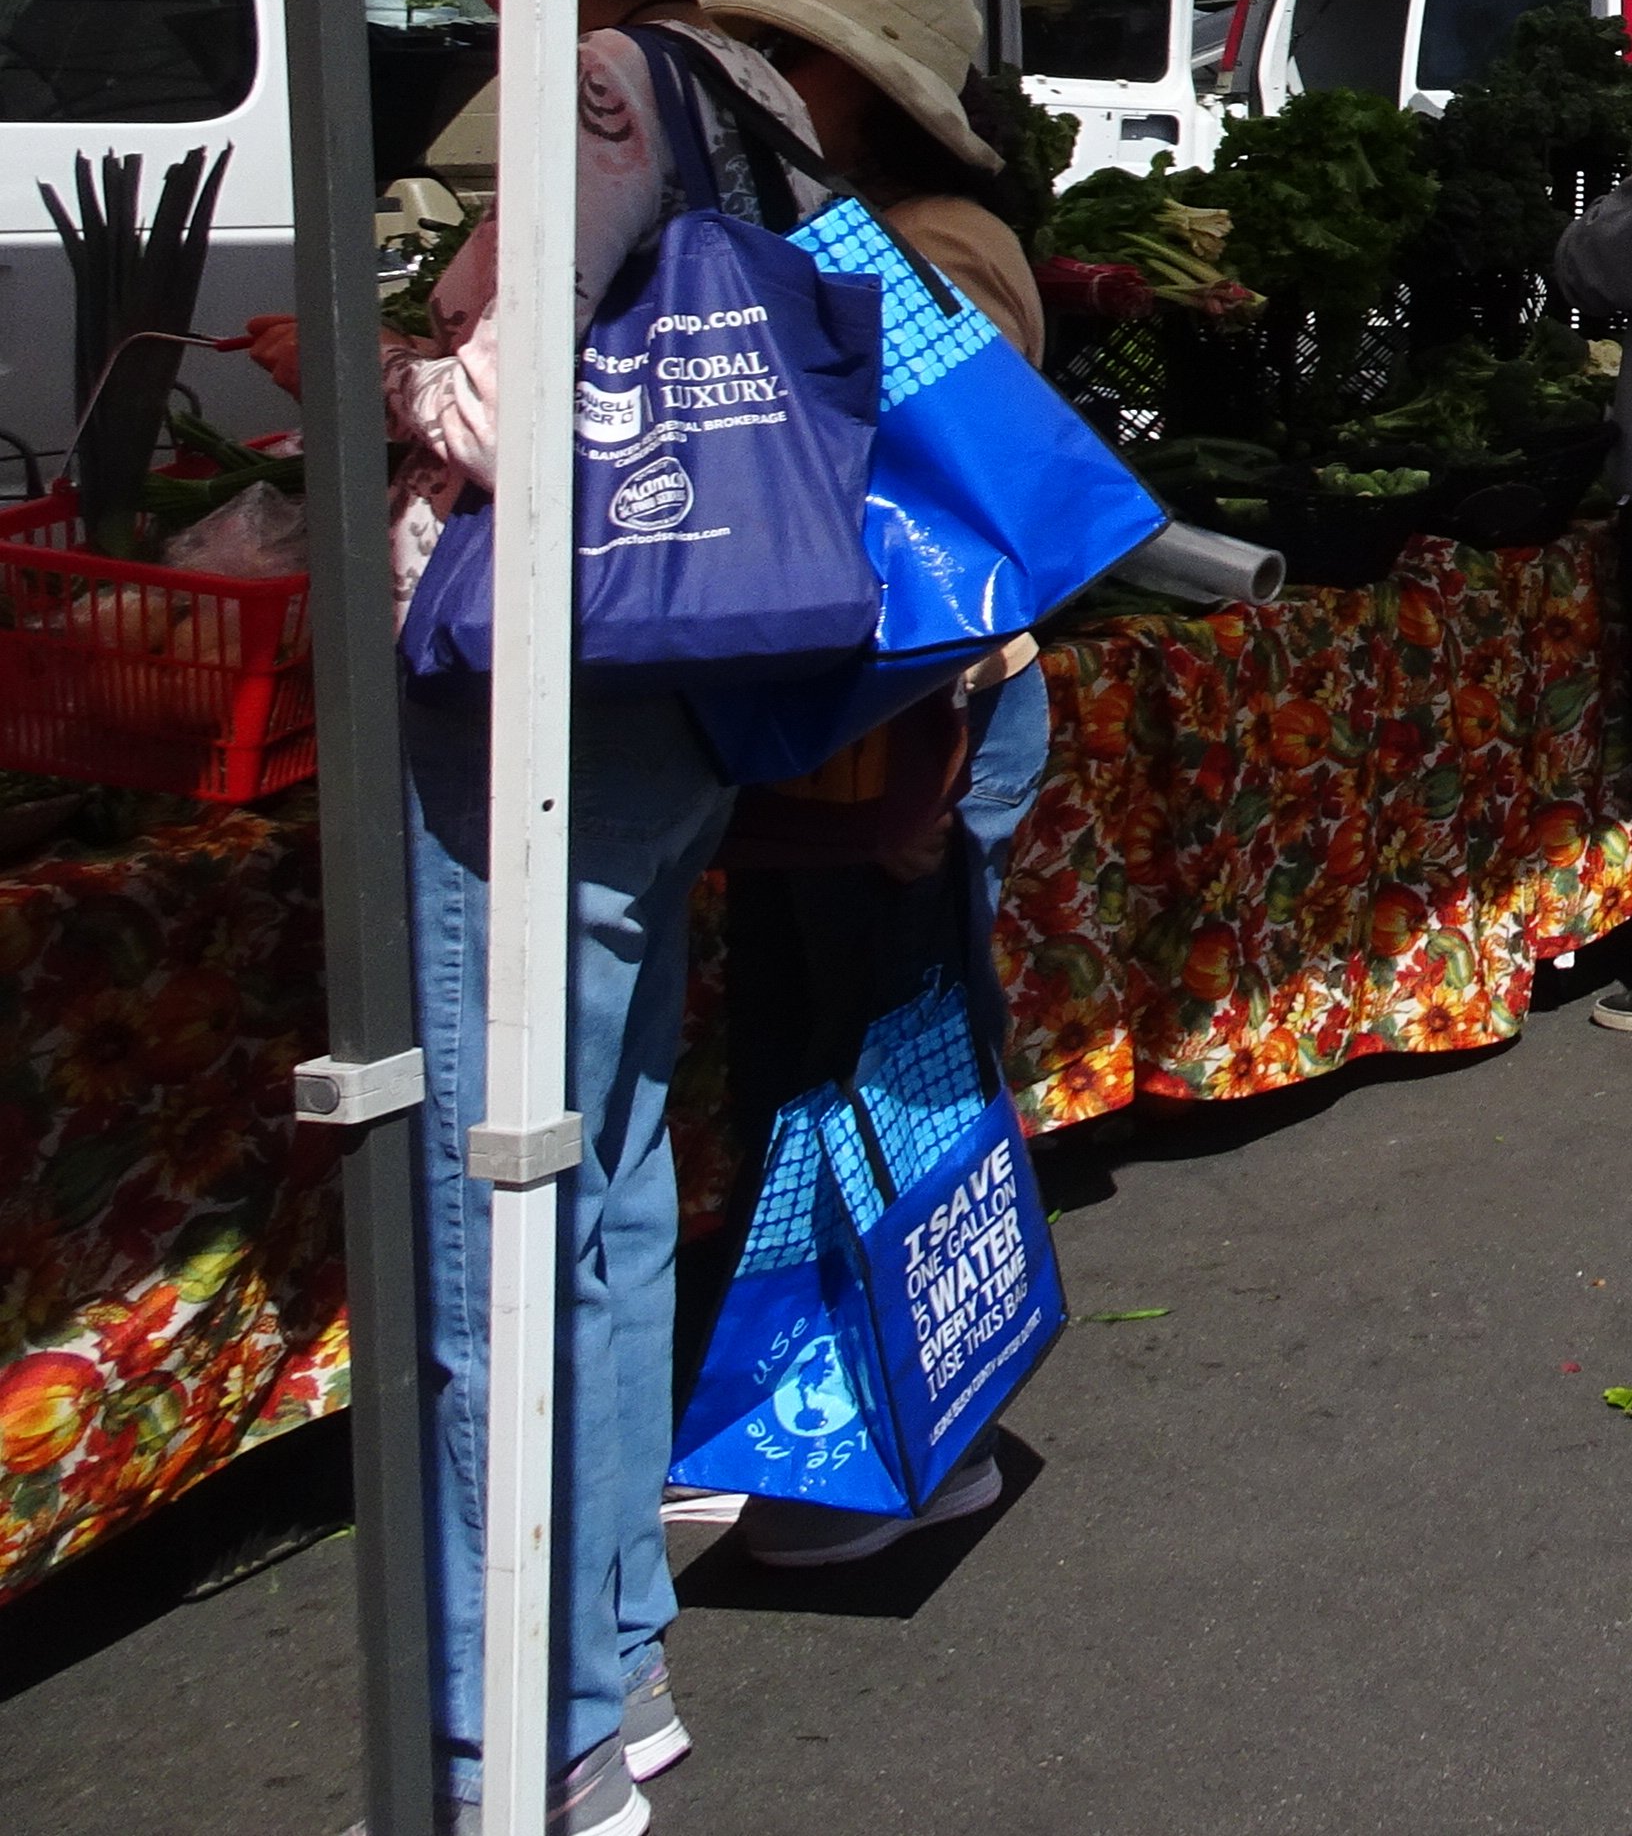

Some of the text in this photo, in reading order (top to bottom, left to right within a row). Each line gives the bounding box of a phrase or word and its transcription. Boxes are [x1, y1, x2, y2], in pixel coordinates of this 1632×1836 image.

[656, 351, 769, 381] GLOBAL
[660, 376, 781, 410] LUXURY
[702, 410, 788, 432] BROKERAGE
[904, 1137, 1013, 1274] I SAVE
[907, 1174, 1017, 1299] ONE GALLON
[911, 1206, 1022, 1342] OF WATER
[920, 1243, 1027, 1373] EVERY TIME
[752, 1317, 809, 1386] use
[926, 1272, 1028, 1403] I USE THIS BAG
